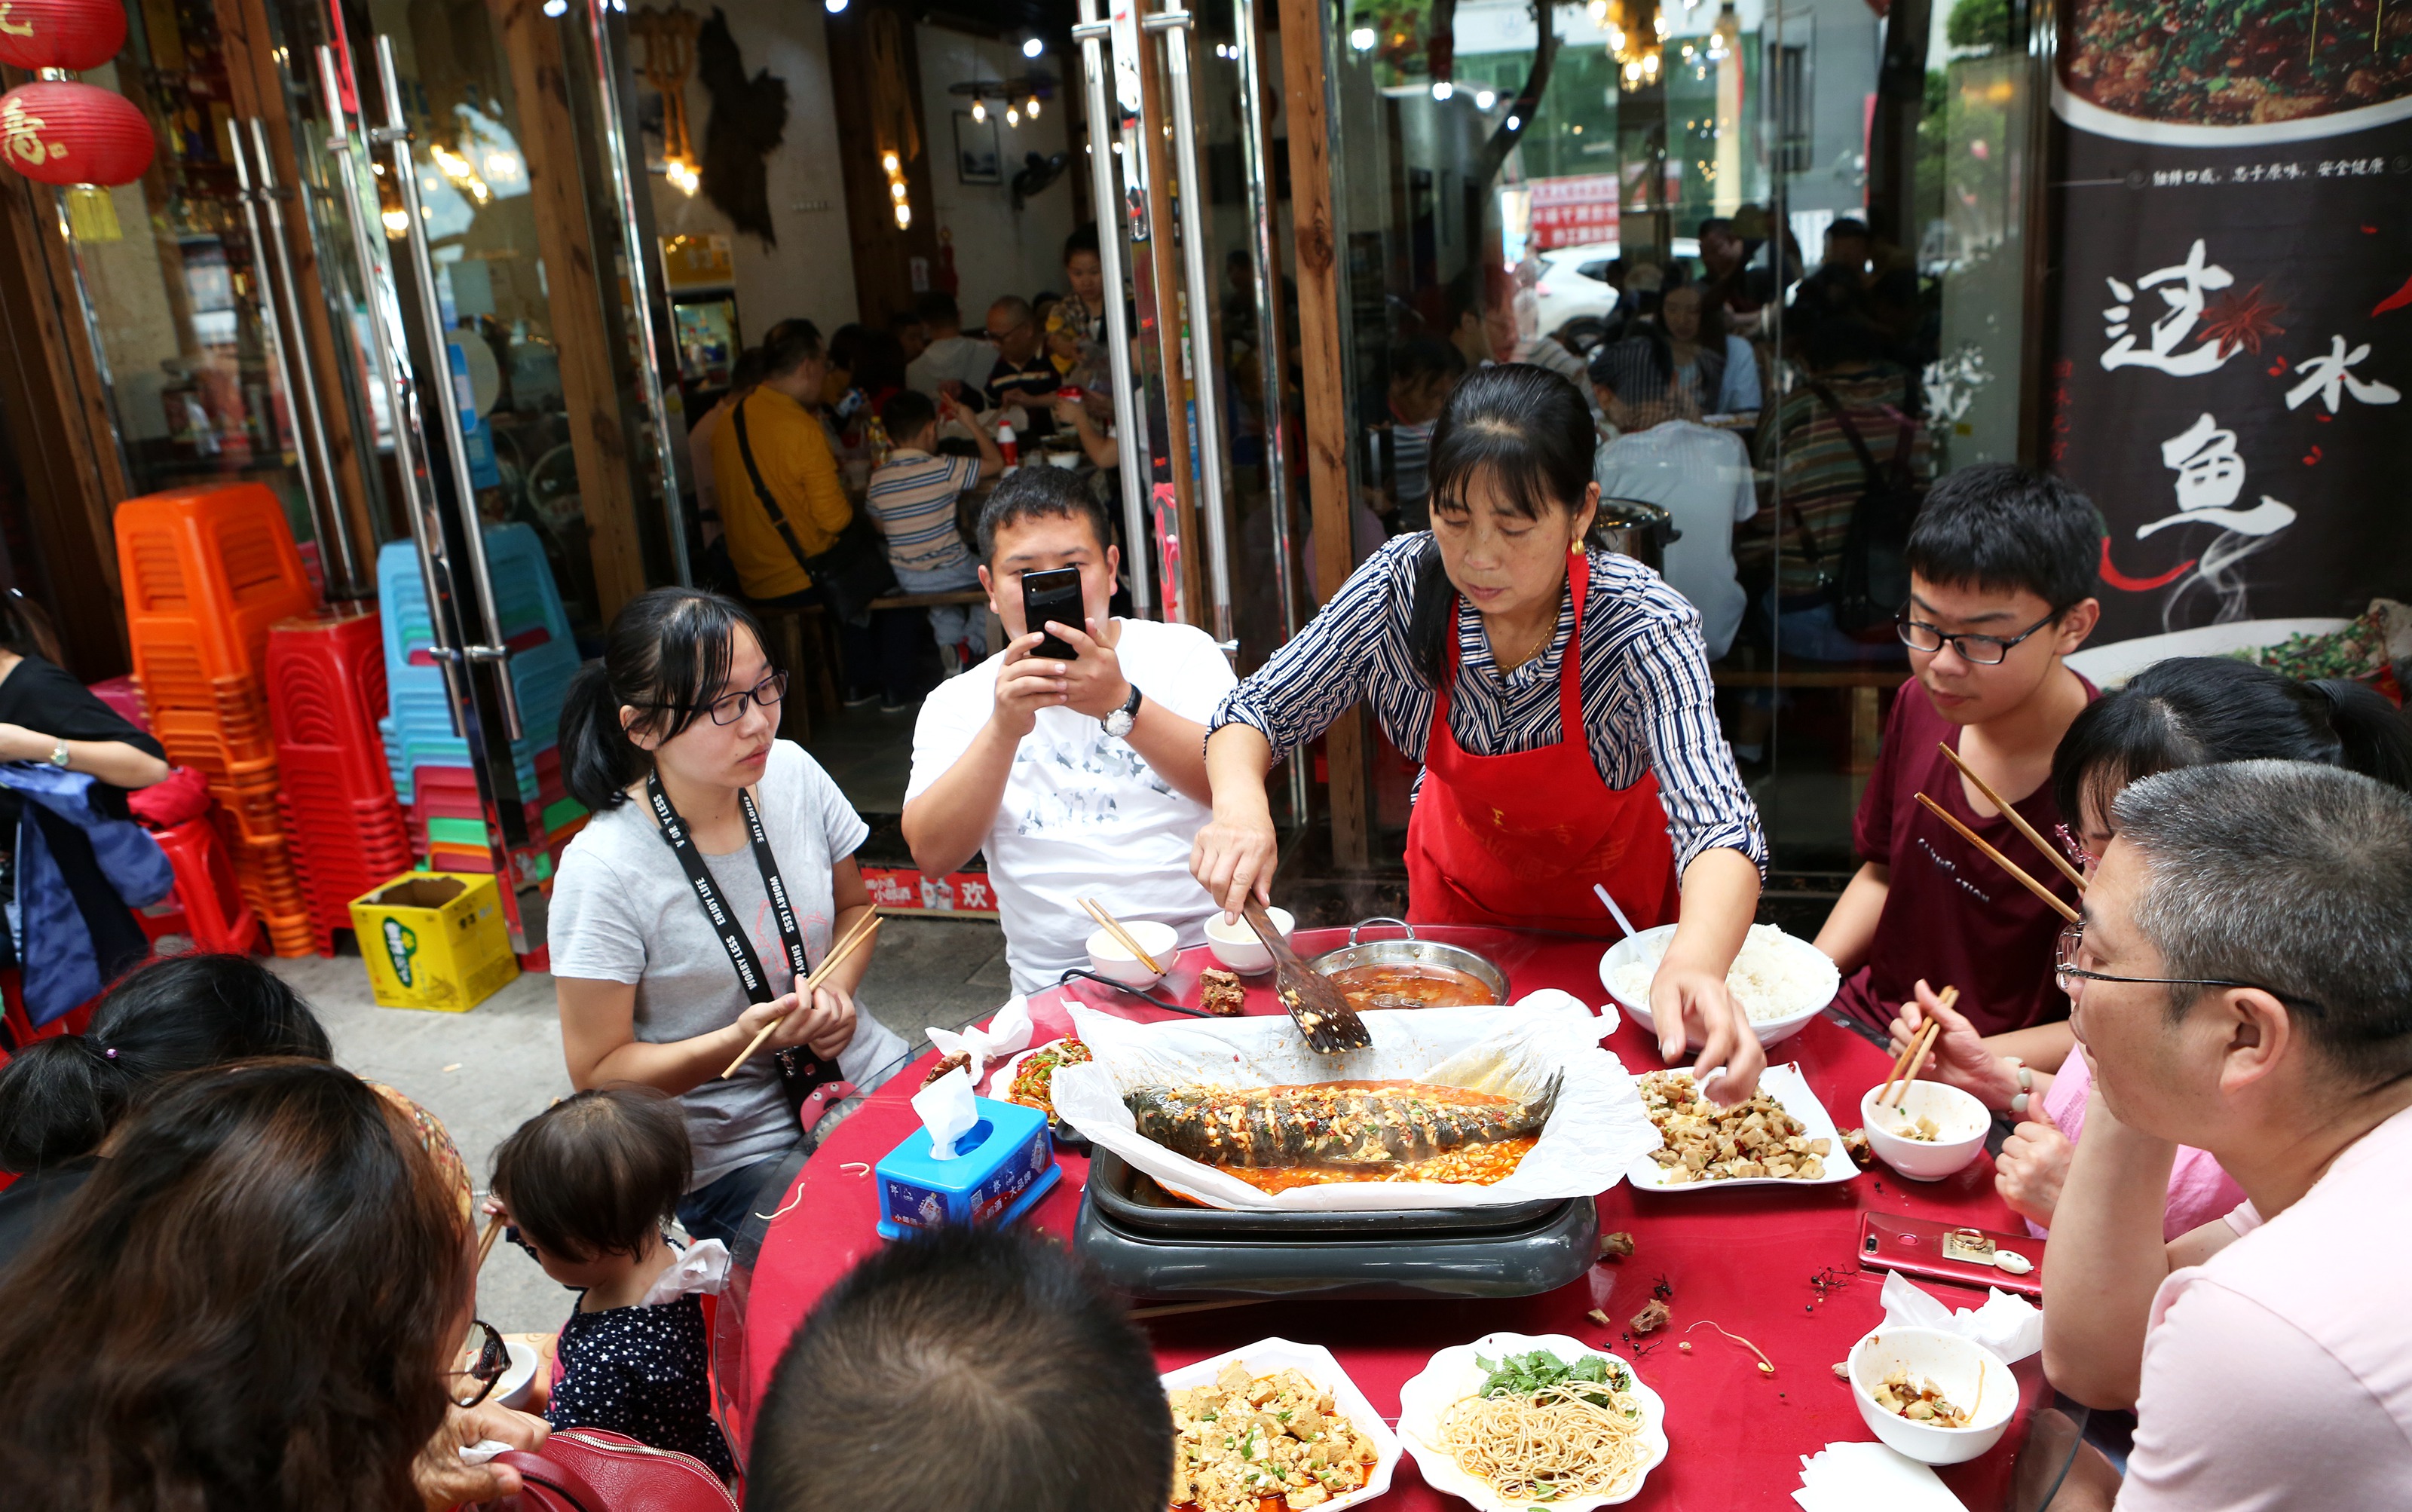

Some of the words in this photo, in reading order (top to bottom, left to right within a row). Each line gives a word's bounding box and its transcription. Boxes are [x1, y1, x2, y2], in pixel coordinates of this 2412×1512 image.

[2285, 334, 2401, 414] 水
[2135, 412, 2297, 540] 鱼
[654, 794, 669, 817] LESS
[743, 796, 758, 824] ENJOY
[752, 822, 765, 843] LIFE
[695, 877, 712, 898] LIFE
[960, 881, 988, 908] 欢
[705, 897, 727, 926] ENJOY
[769, 875, 788, 911] WORRY
[780, 909, 795, 934] LESS
[725, 935, 743, 959] LESS
[791, 944, 807, 974] ENJOY
[736, 958, 758, 991] WORRY
